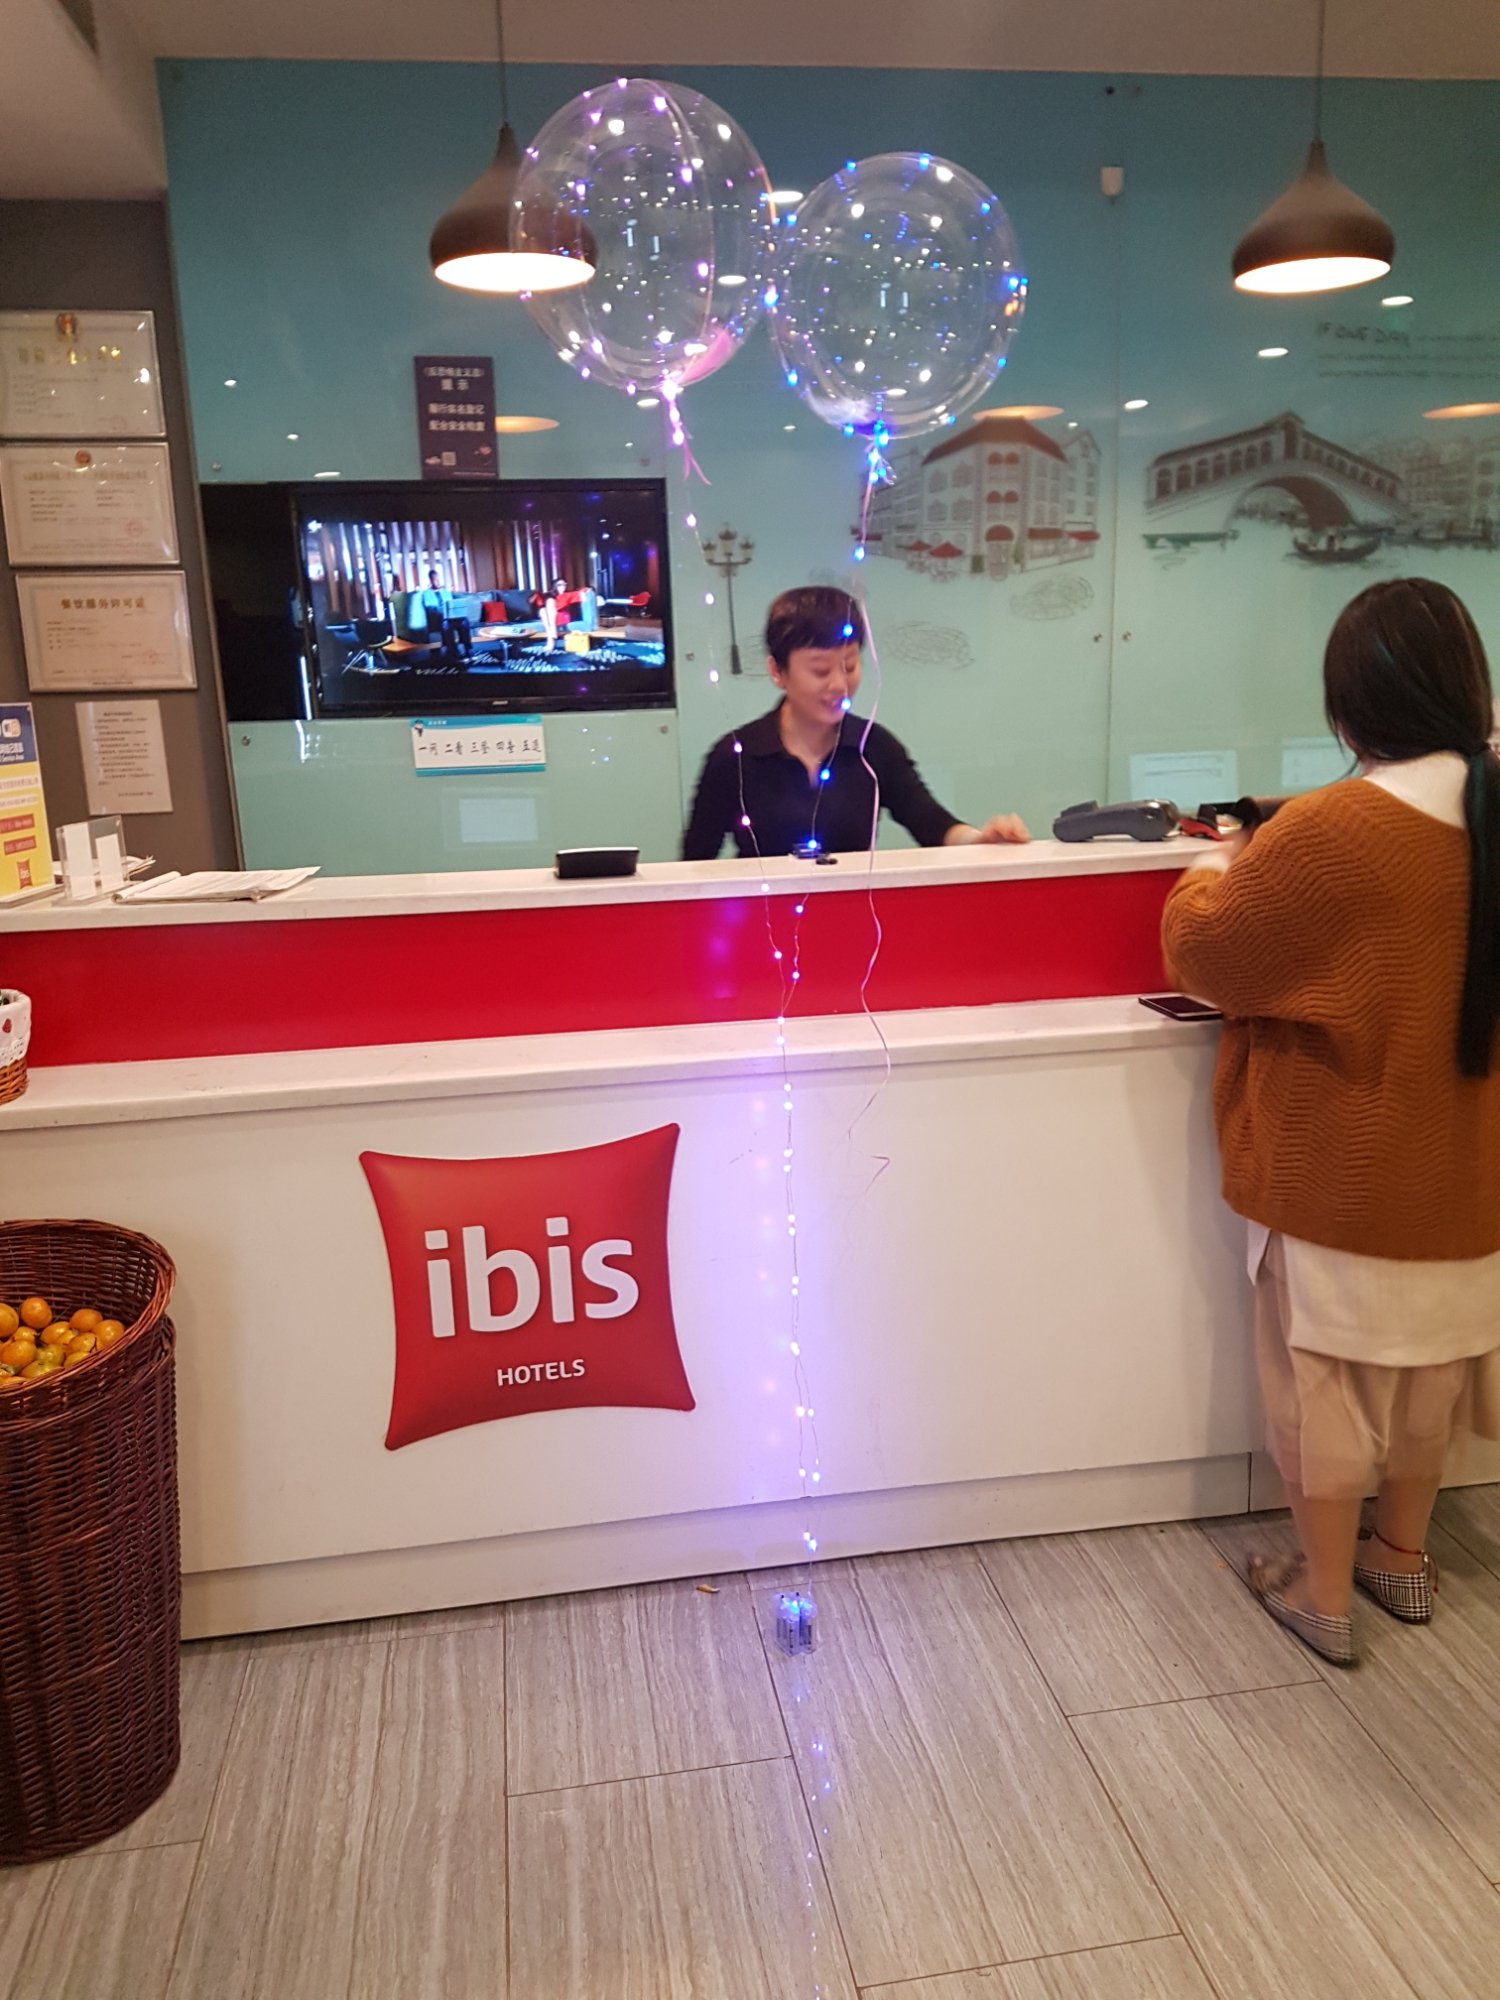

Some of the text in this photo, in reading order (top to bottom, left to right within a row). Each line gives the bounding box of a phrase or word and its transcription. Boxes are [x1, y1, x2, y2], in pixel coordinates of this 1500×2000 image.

[60, 597, 145, 610] 餐饮服务许可证
[424, 1216, 639, 1338] ibis
[497, 1358, 585, 1387] HOTELS
